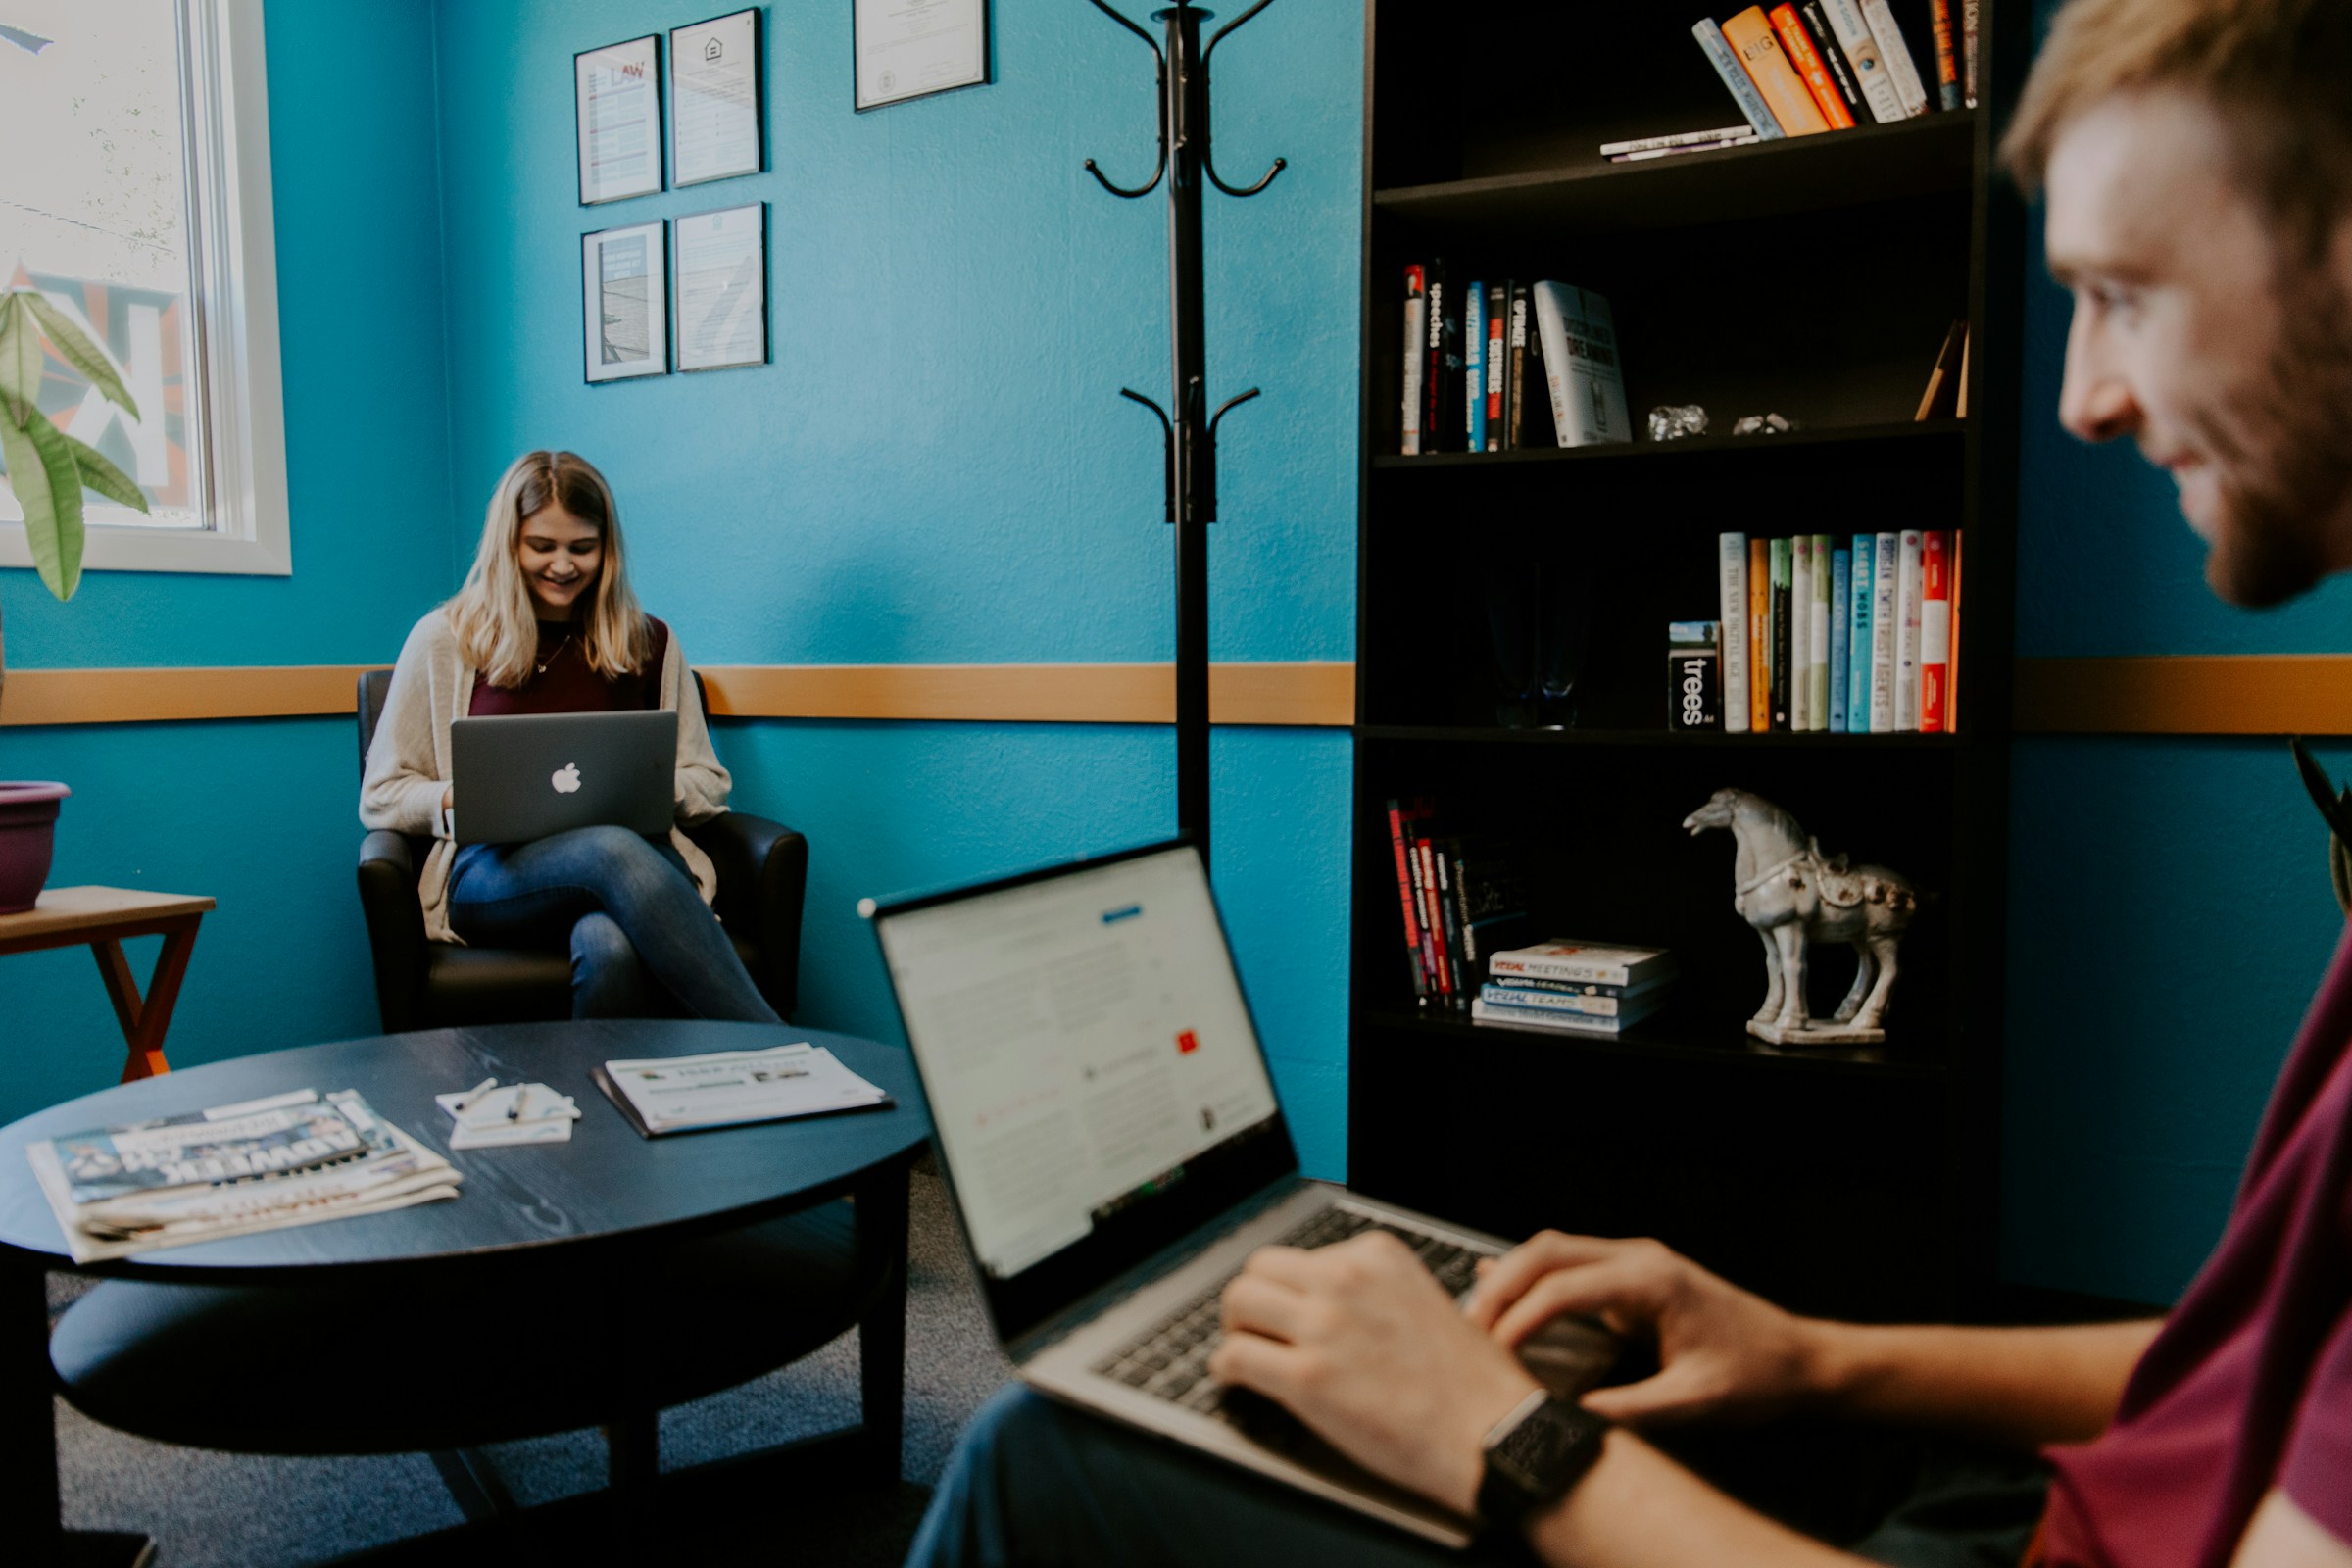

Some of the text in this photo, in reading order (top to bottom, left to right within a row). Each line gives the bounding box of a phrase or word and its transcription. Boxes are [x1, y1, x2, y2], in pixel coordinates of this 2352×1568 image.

[1428, 282, 1444, 347] speeches
[1511, 299, 1526, 347] OPTIMIZE
[1856, 540, 1869, 628] SMART MOBS
[1876, 621, 1891, 658] TRUST
[1682, 658, 1707, 724] trees
[1527, 960, 1592, 979] MEETINGS
[1531, 993, 1576, 1008] TEAMS
